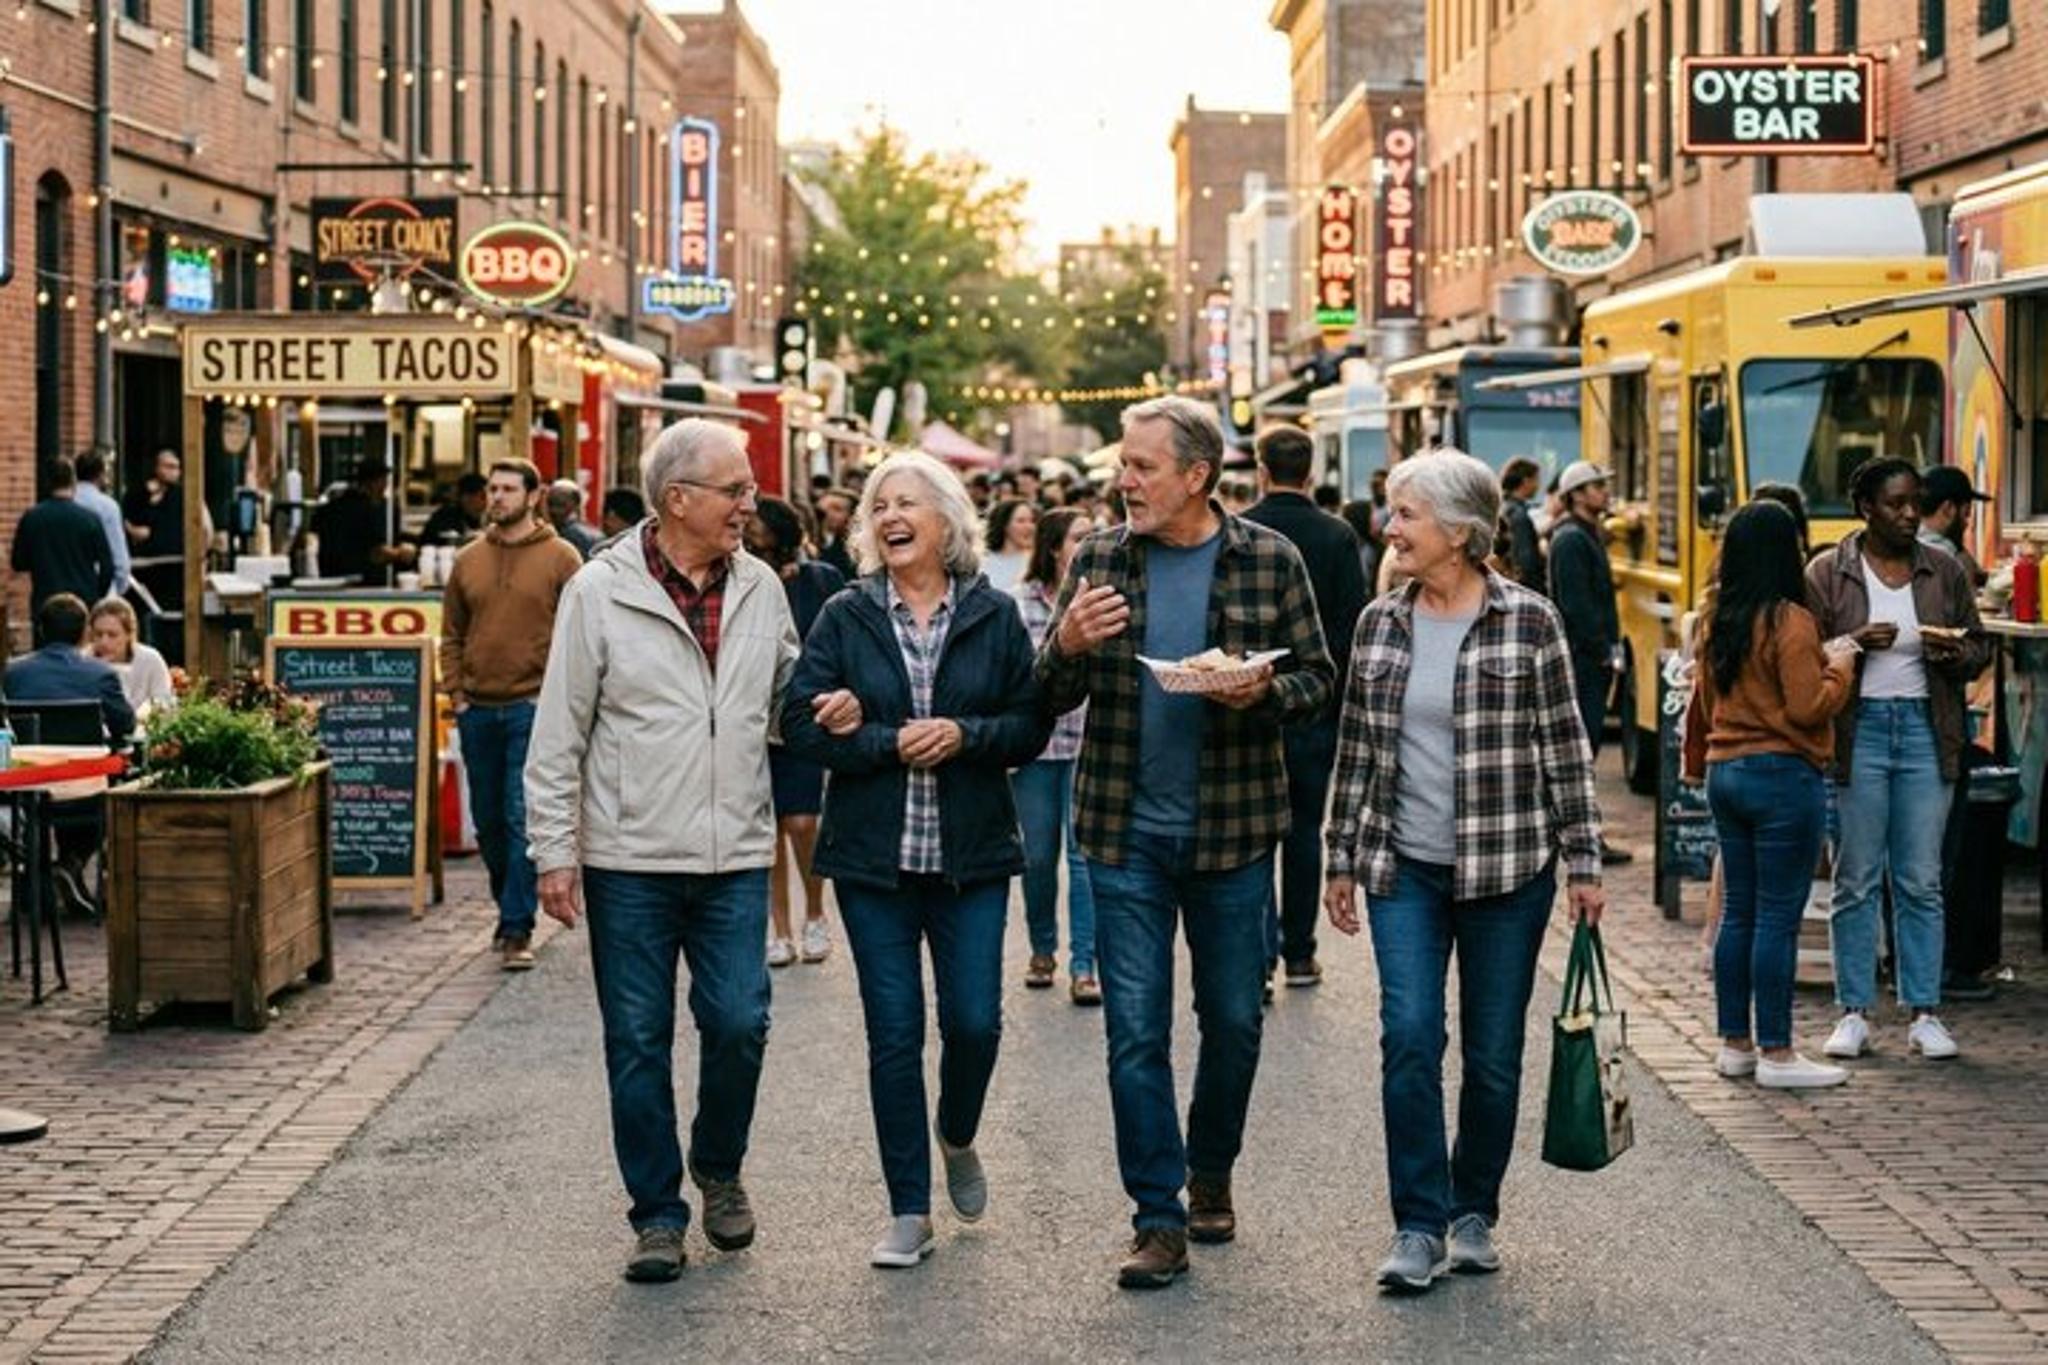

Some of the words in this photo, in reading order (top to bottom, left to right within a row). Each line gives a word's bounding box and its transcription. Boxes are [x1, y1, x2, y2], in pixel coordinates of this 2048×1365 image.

[1693, 70, 1861, 104] OYSTER
[1733, 107, 1821, 140] BAR
[681, 132, 707, 265] BIER
[1384, 129, 1415, 306] OYSTER
[318, 217, 388, 263] STREET
[470, 246, 563, 283] BBQ
[202, 338, 350, 382] STREET
[372, 338, 499, 382] TACOS
[288, 607, 426, 636] BBQ
